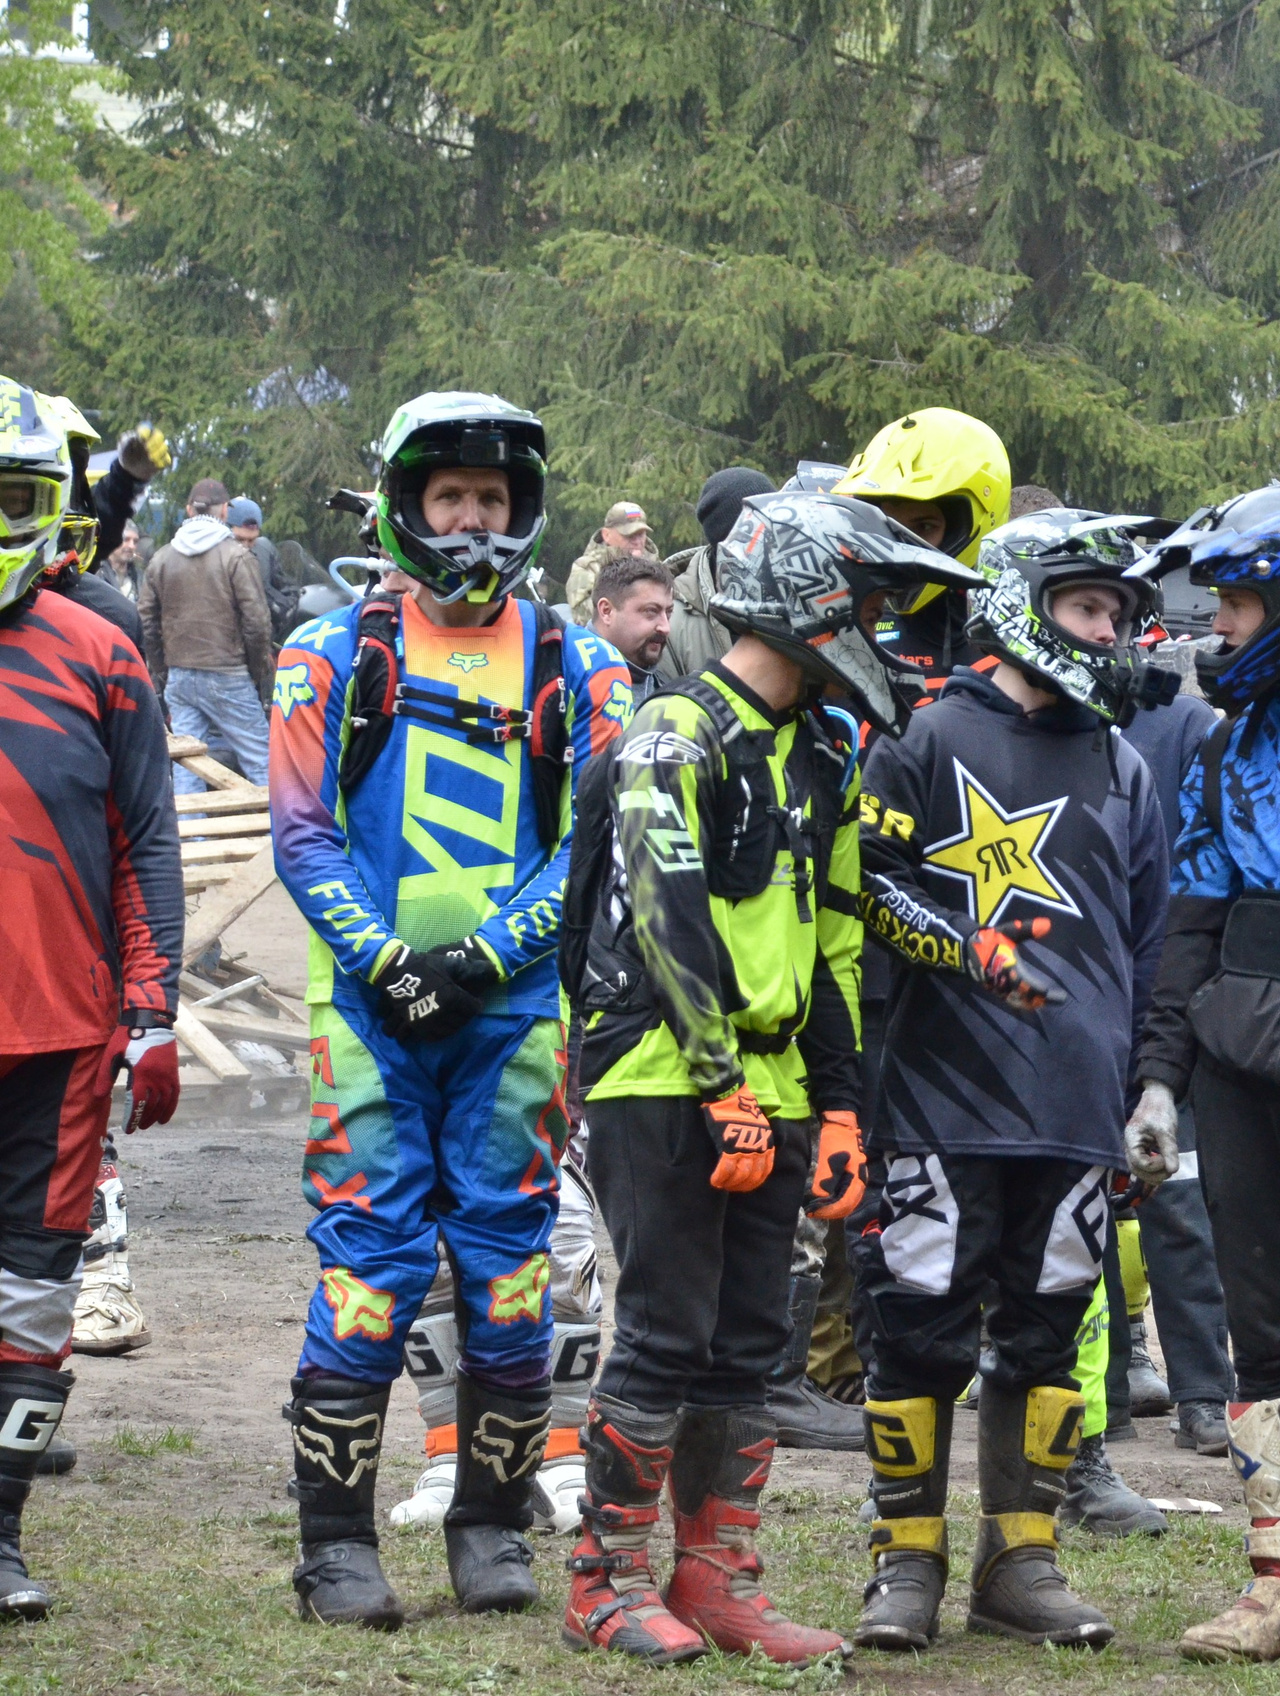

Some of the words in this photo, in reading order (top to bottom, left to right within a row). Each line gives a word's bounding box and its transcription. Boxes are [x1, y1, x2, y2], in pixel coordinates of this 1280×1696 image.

[619, 786, 704, 873] FLY
[307, 880, 387, 952] FOX
[408, 990, 440, 1021] FOX
[722, 1123, 773, 1151] FOX
